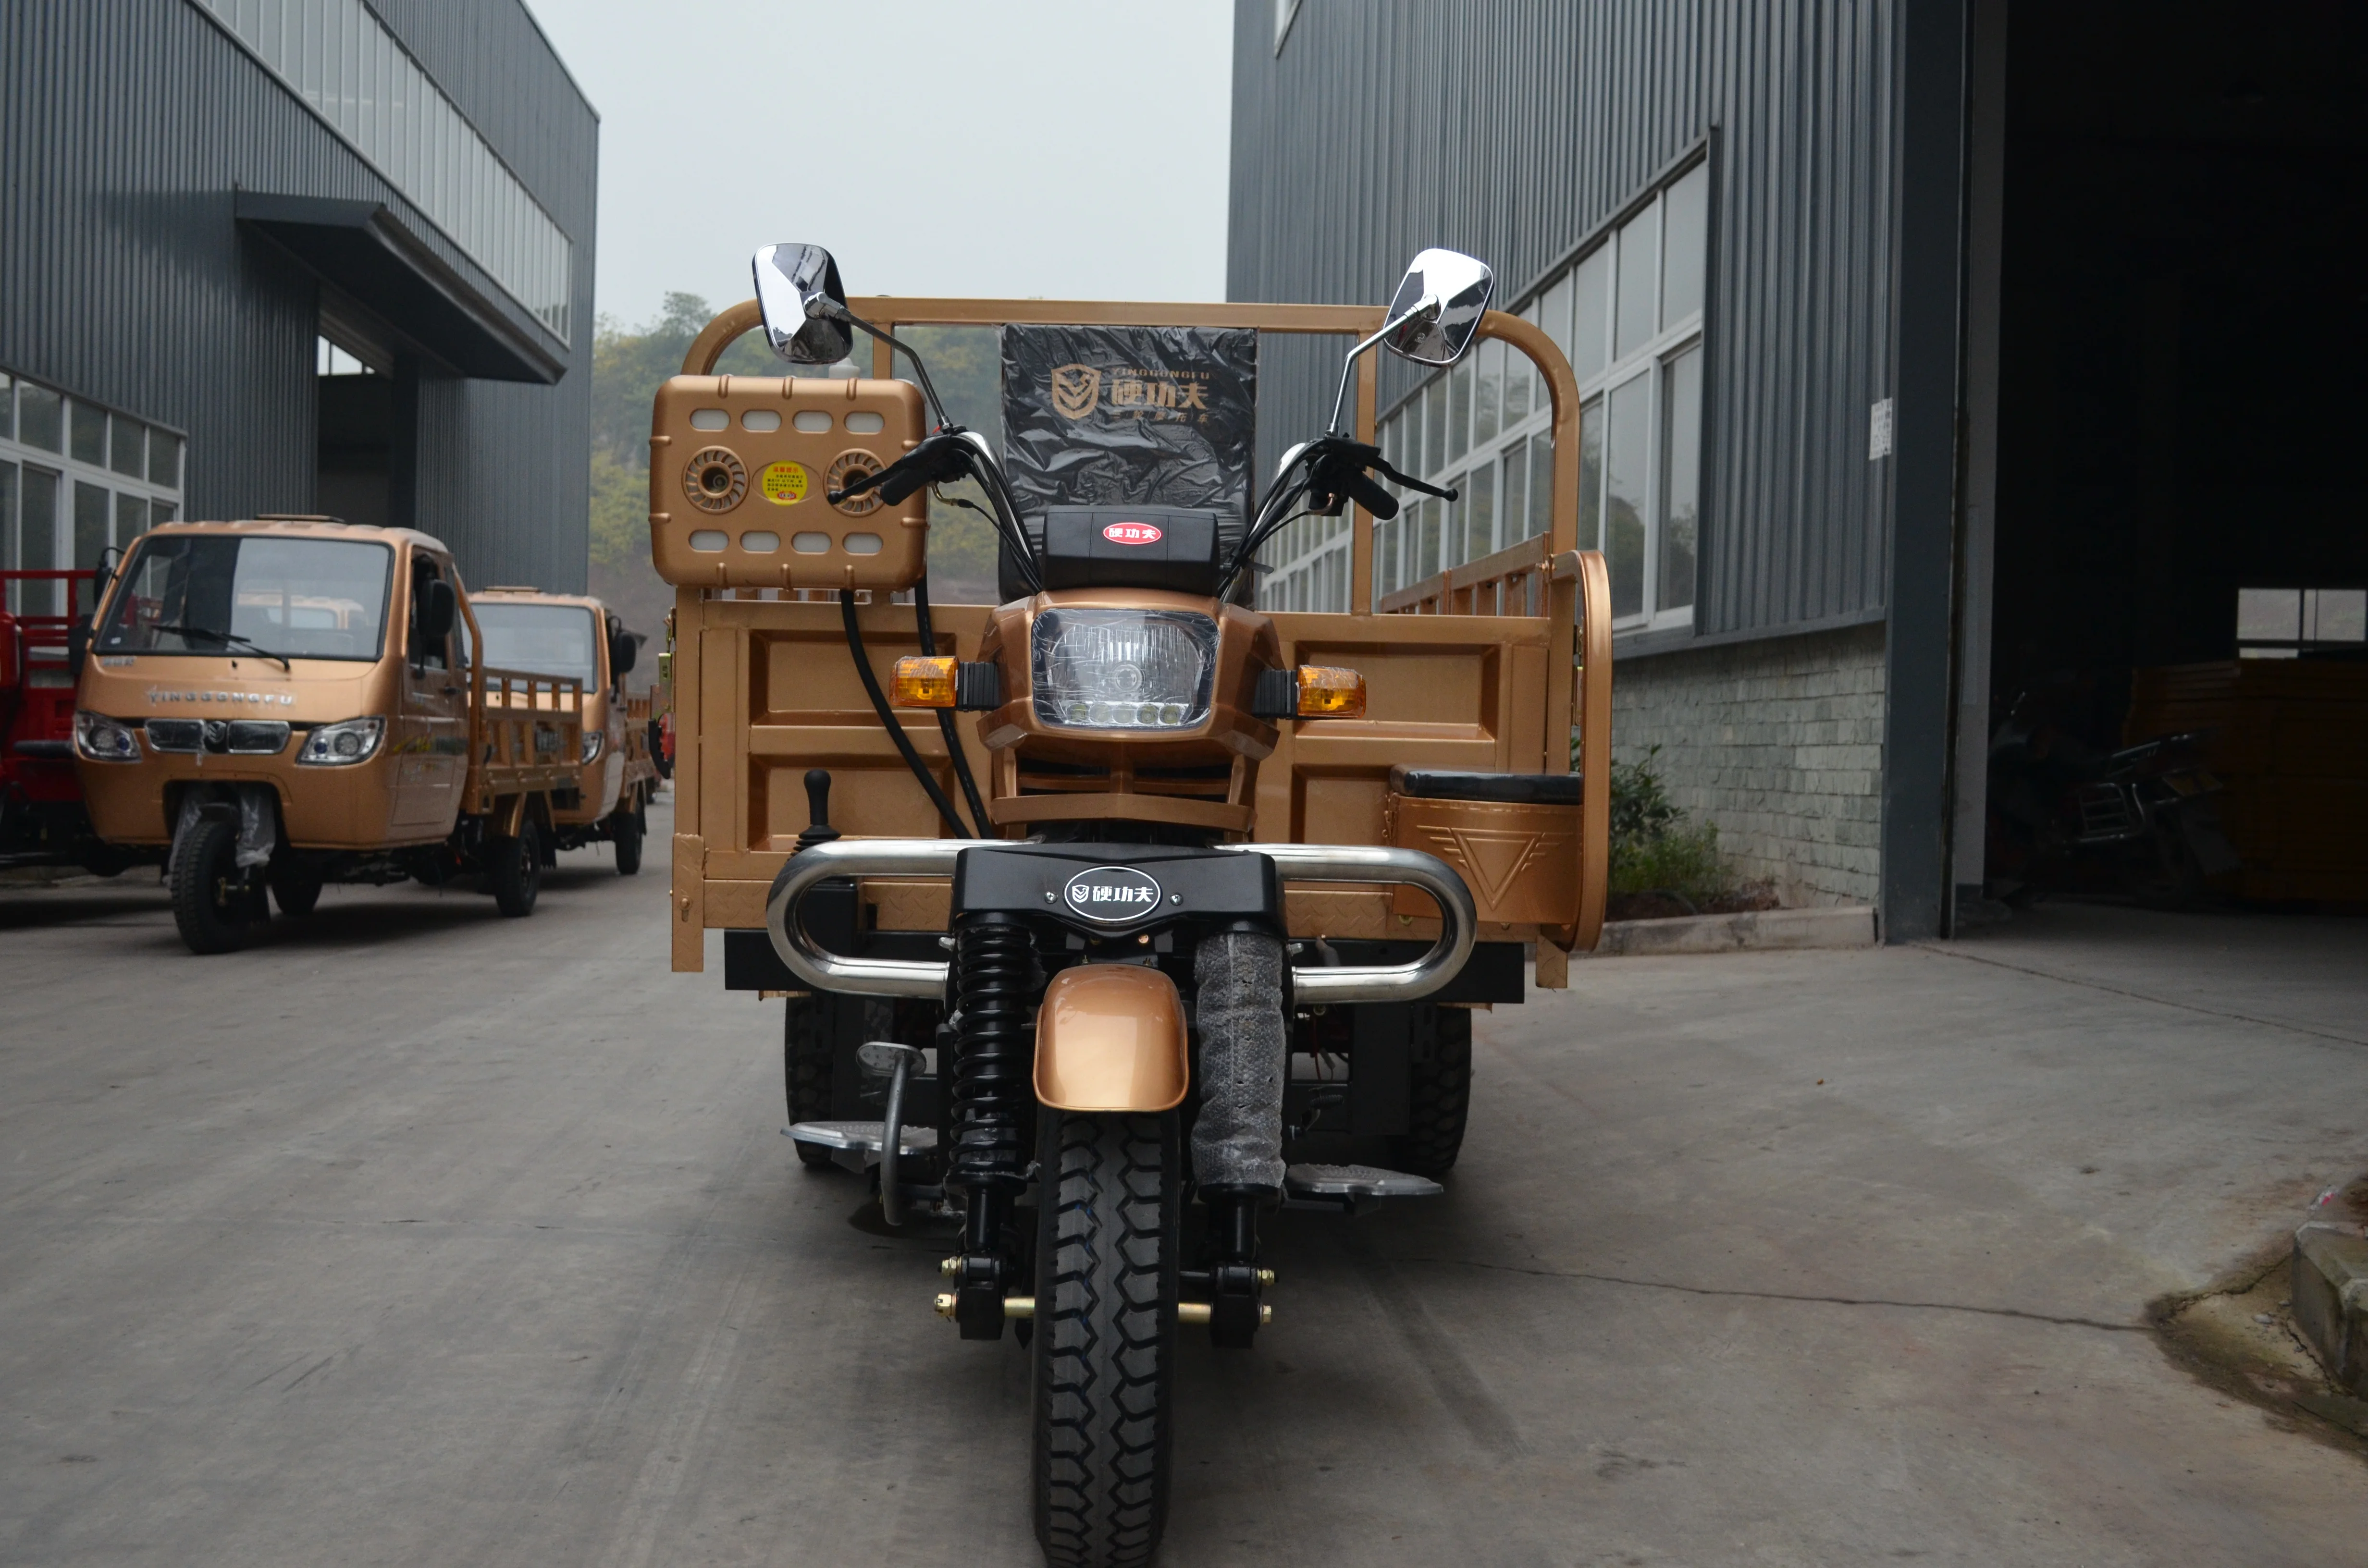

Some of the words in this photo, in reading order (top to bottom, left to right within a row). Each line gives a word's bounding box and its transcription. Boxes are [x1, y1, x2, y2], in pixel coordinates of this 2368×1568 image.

[1111, 379, 1209, 409] 硬功夫
[1109, 528, 1156, 539] 硬功夫
[1093, 886, 1153, 902] 硬功夫
